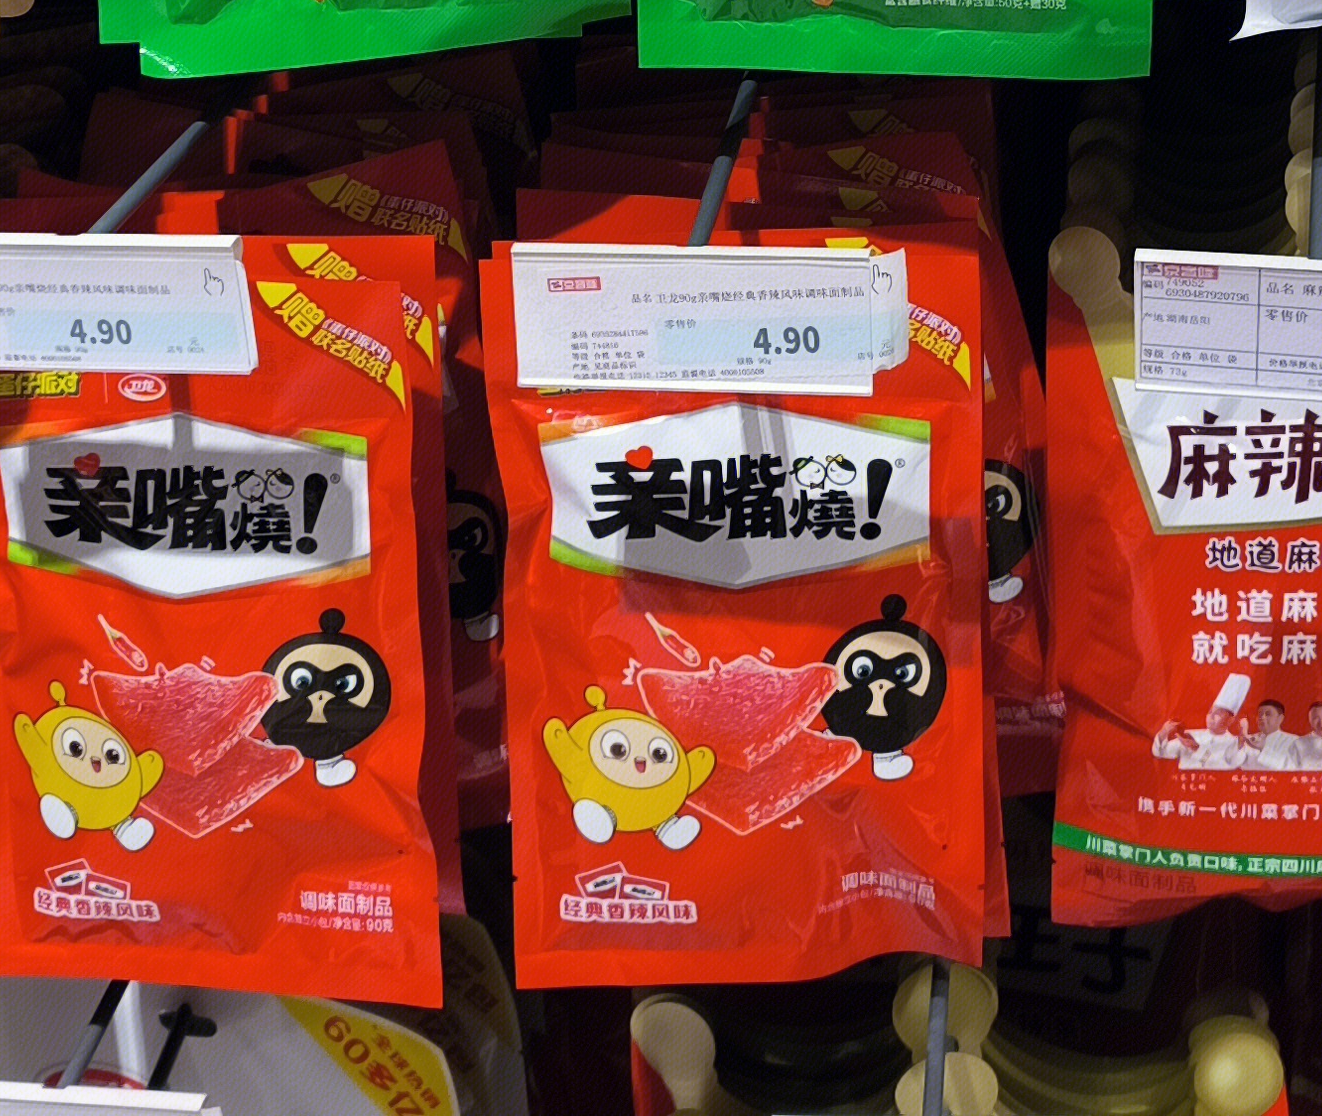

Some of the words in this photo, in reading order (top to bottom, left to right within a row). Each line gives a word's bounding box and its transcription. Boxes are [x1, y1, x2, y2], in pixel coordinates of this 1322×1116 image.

[274, 291, 326, 339] 赠
[70, 318, 133, 346] 4.90
[753, 325, 821, 356] 4.90
[309, 328, 389, 384] 联名贴纸
[35, 890, 159, 921] 经典香辣风味
[299, 890, 394, 918] 调味面制品
[562, 898, 695, 922] 经典香辣风味
